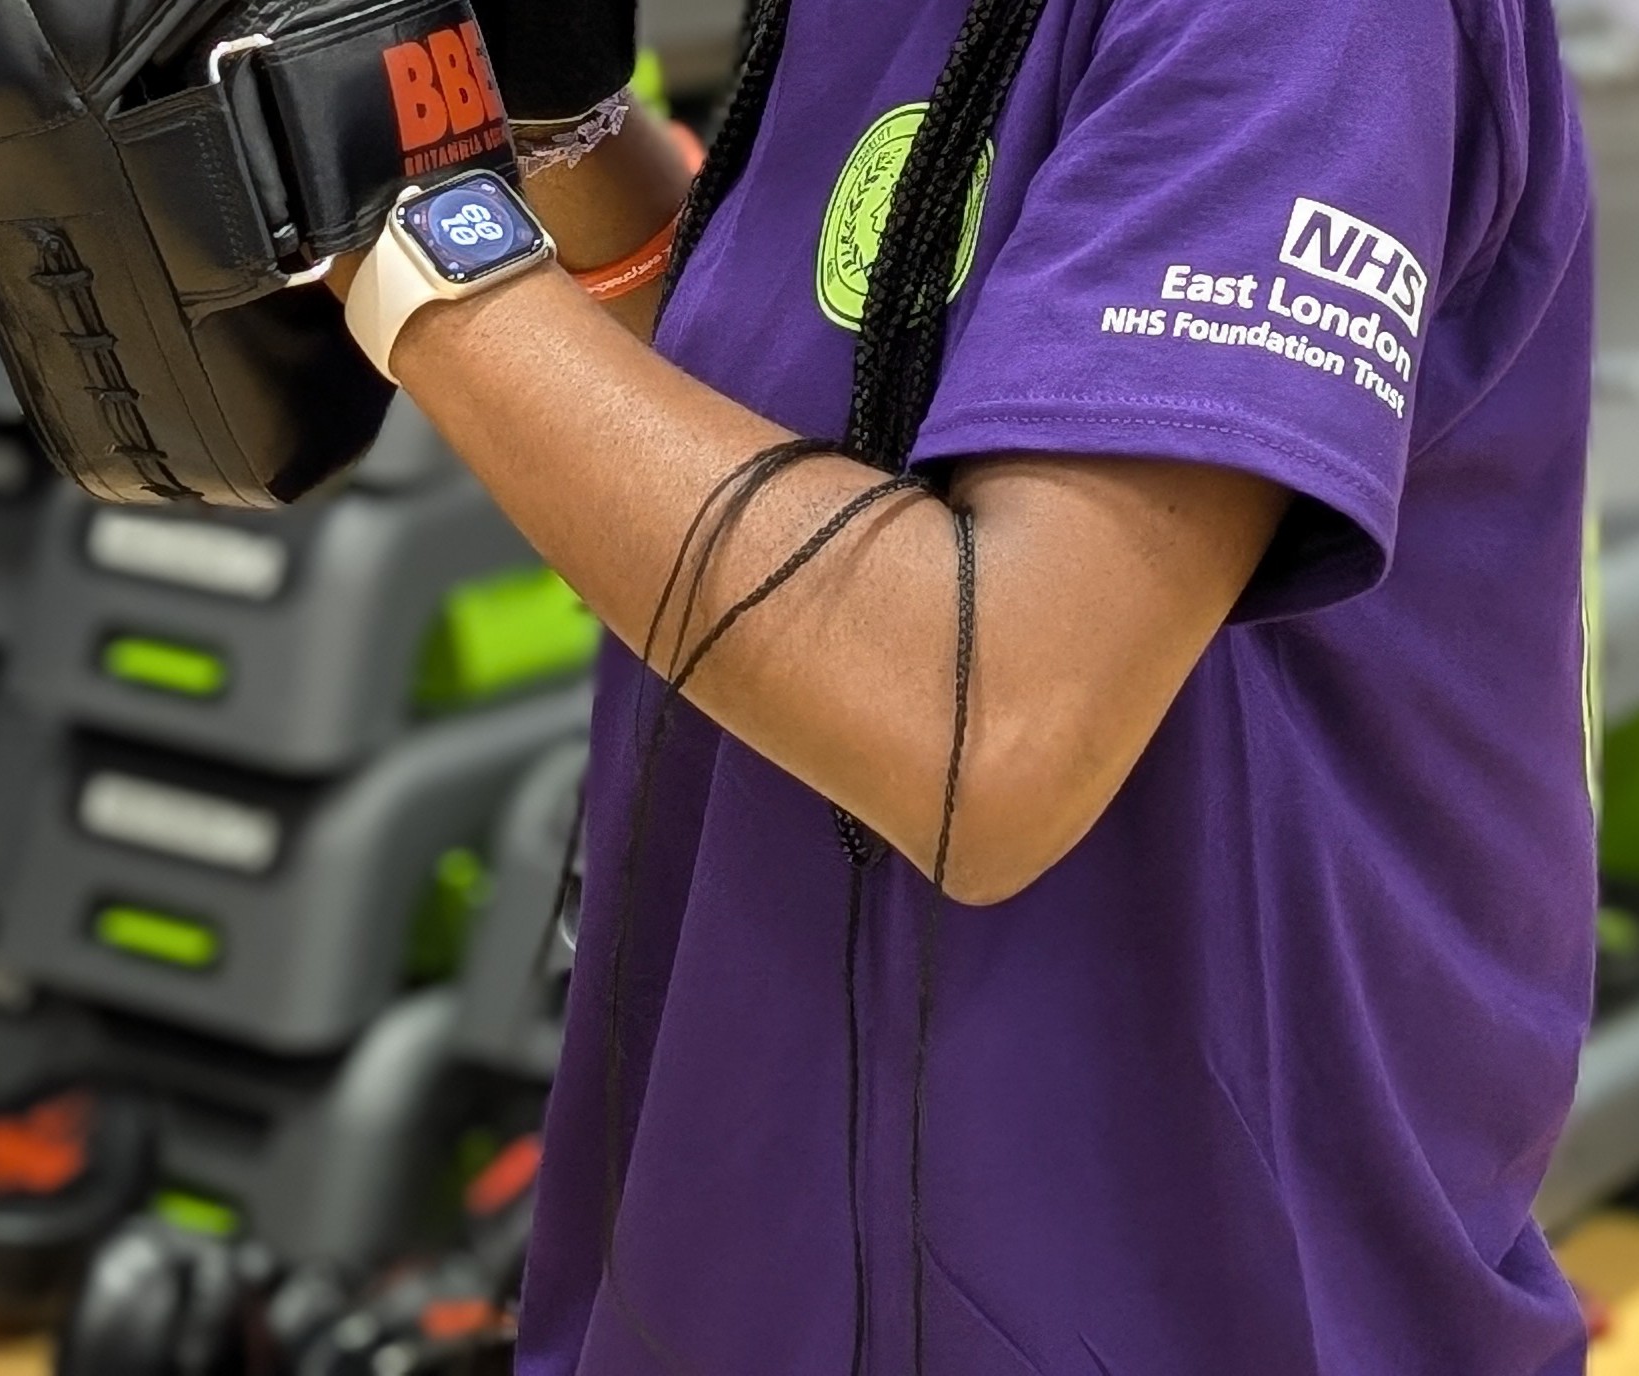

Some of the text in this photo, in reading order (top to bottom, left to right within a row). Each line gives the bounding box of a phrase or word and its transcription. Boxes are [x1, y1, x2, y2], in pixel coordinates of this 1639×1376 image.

[1288, 209, 1423, 318] NHS
[1101, 307, 1406, 419] NHS Foundation Trust
[1161, 264, 1412, 382] East London
